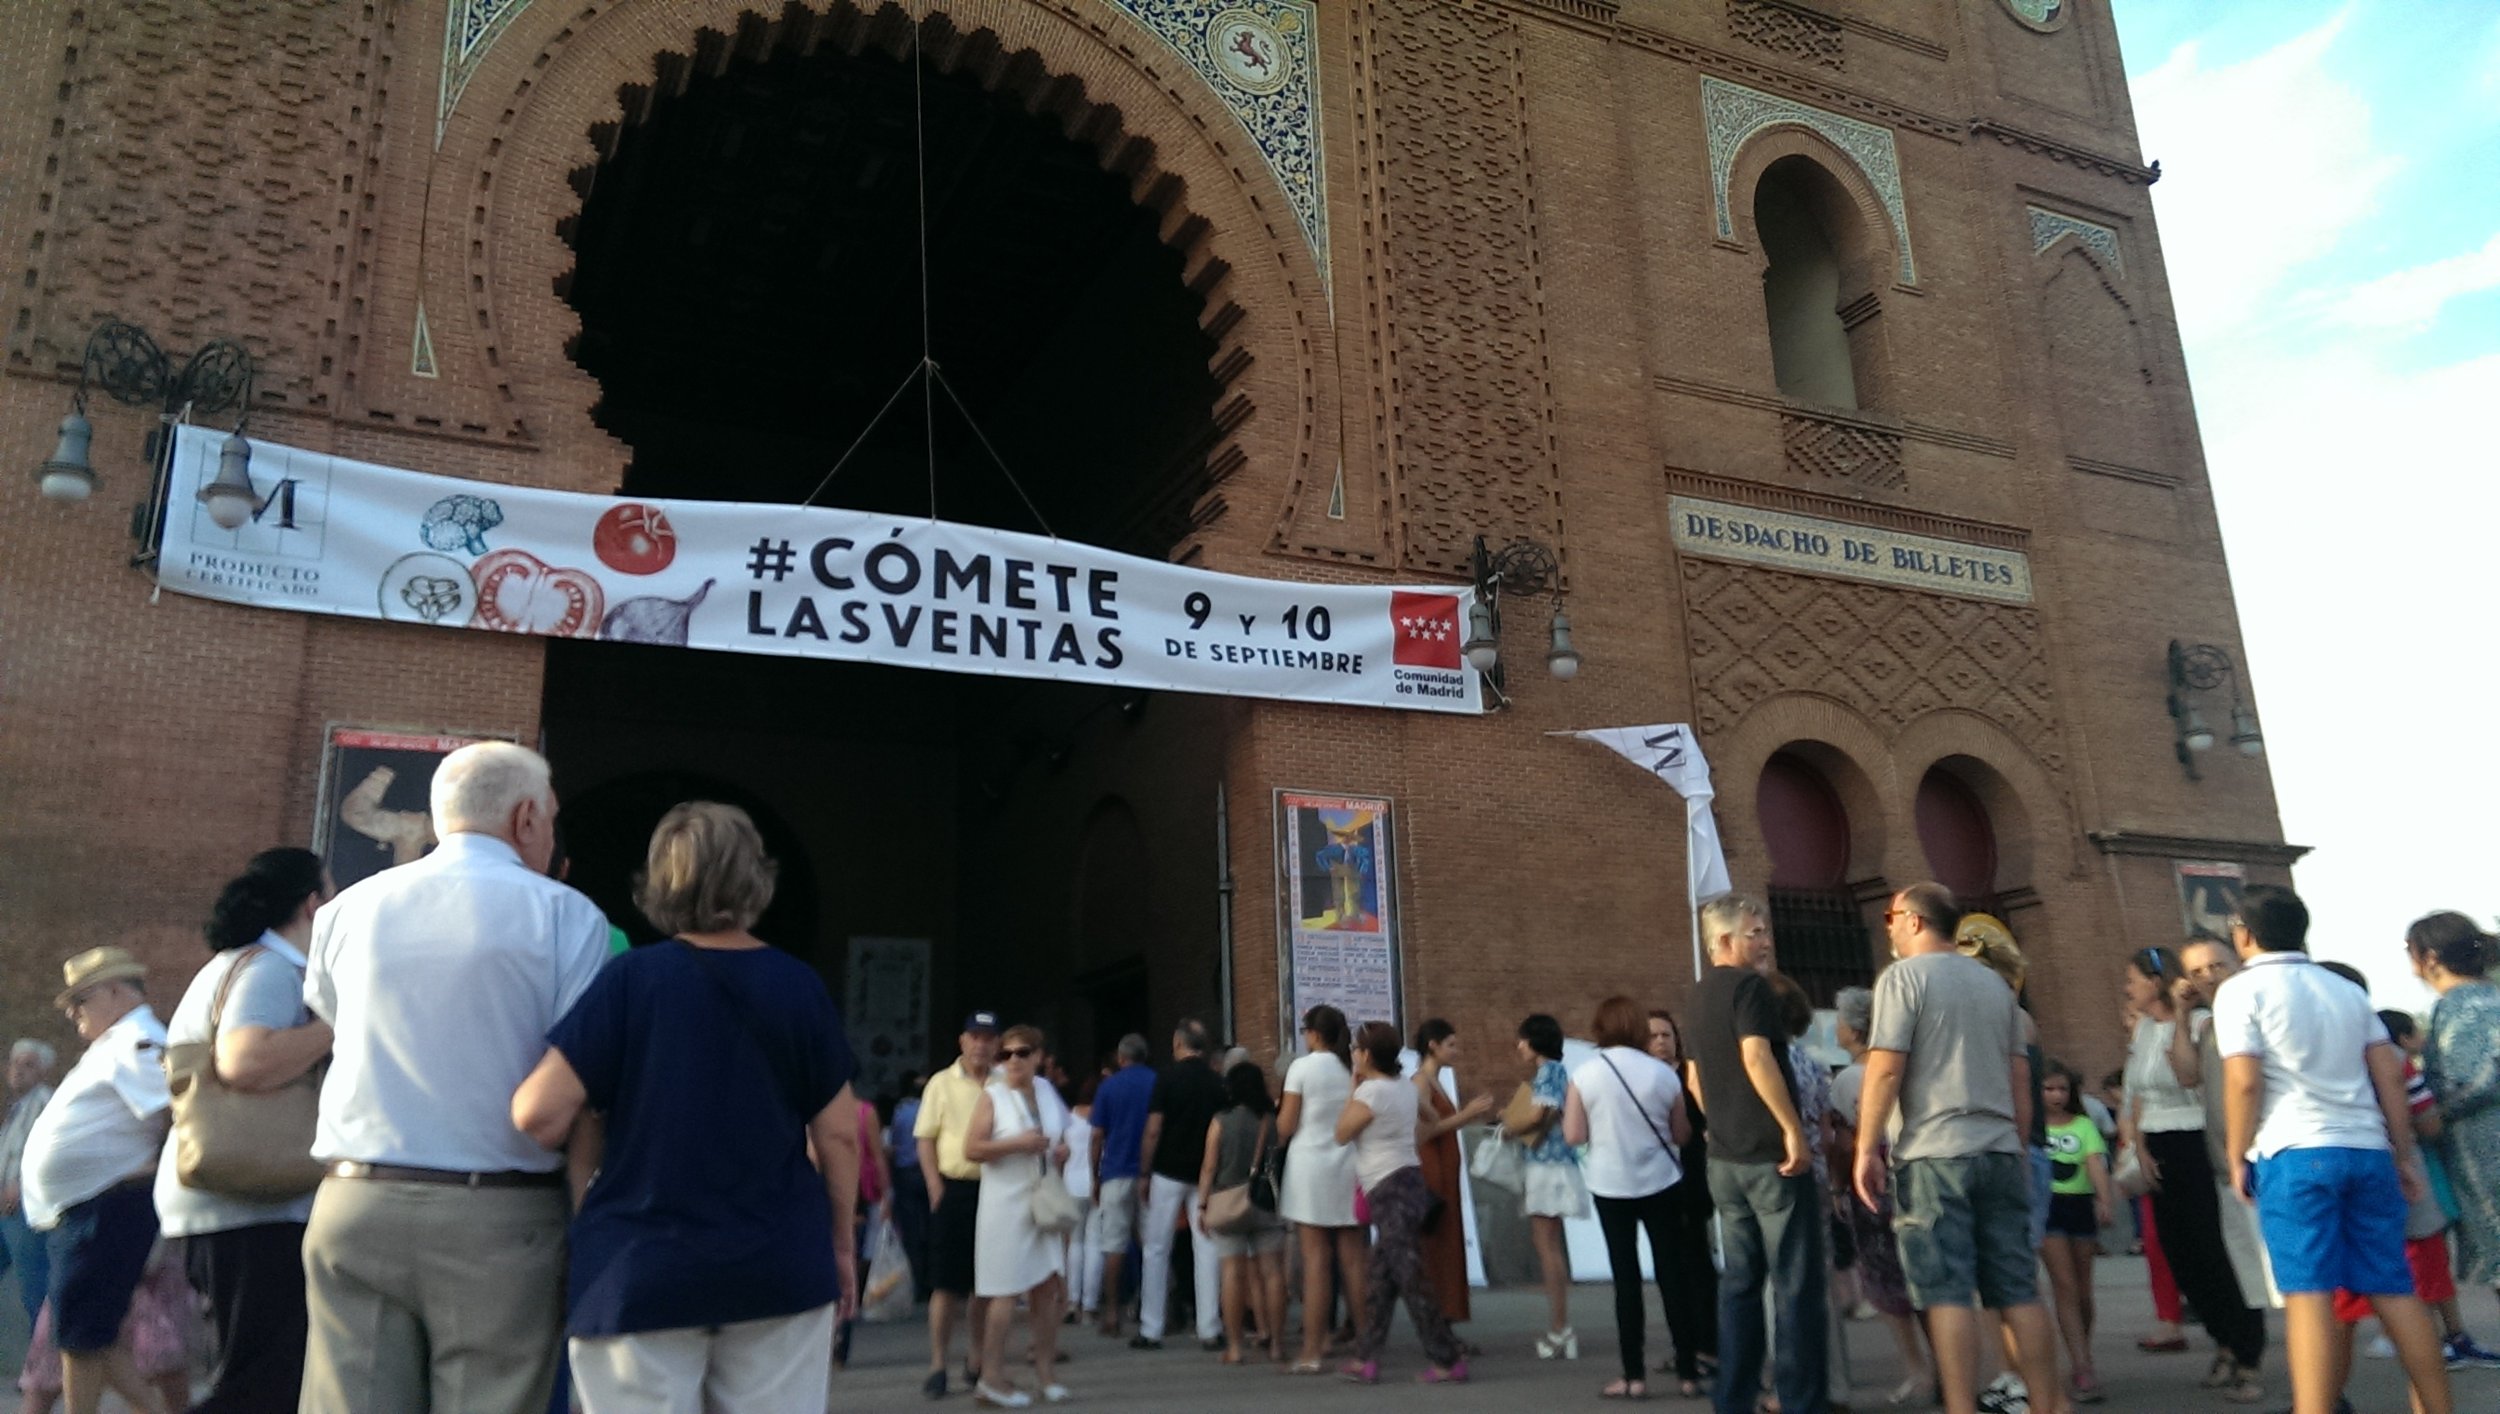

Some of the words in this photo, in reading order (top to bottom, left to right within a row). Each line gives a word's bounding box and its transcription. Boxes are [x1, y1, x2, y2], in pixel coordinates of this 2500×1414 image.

[190, 552, 320, 581] PRODUCTO
[1687, 513, 1829, 556] DESPACHO
[1843, 538, 1880, 564] DE
[1892, 546, 2013, 586] BILLETES
[186, 569, 319, 595] CERTIFICADO
[746, 527, 1119, 620] #CÓMETE
[747, 590, 1124, 669] LASVENTAS
[1183, 591, 1212, 630] 9
[1239, 614, 1256, 635] Y
[1281, 604, 1332, 642] 10
[1165, 638, 1198, 659] DE
[1210, 643, 1363, 675] SEPTIEMBRE
[1393, 669, 1464, 686] Comunidad
[1395, 682, 1413, 694] de
[1417, 683, 1464, 699] Madrid
[1642, 724, 1687, 773] M
[1345, 800, 1385, 812] MADRID
